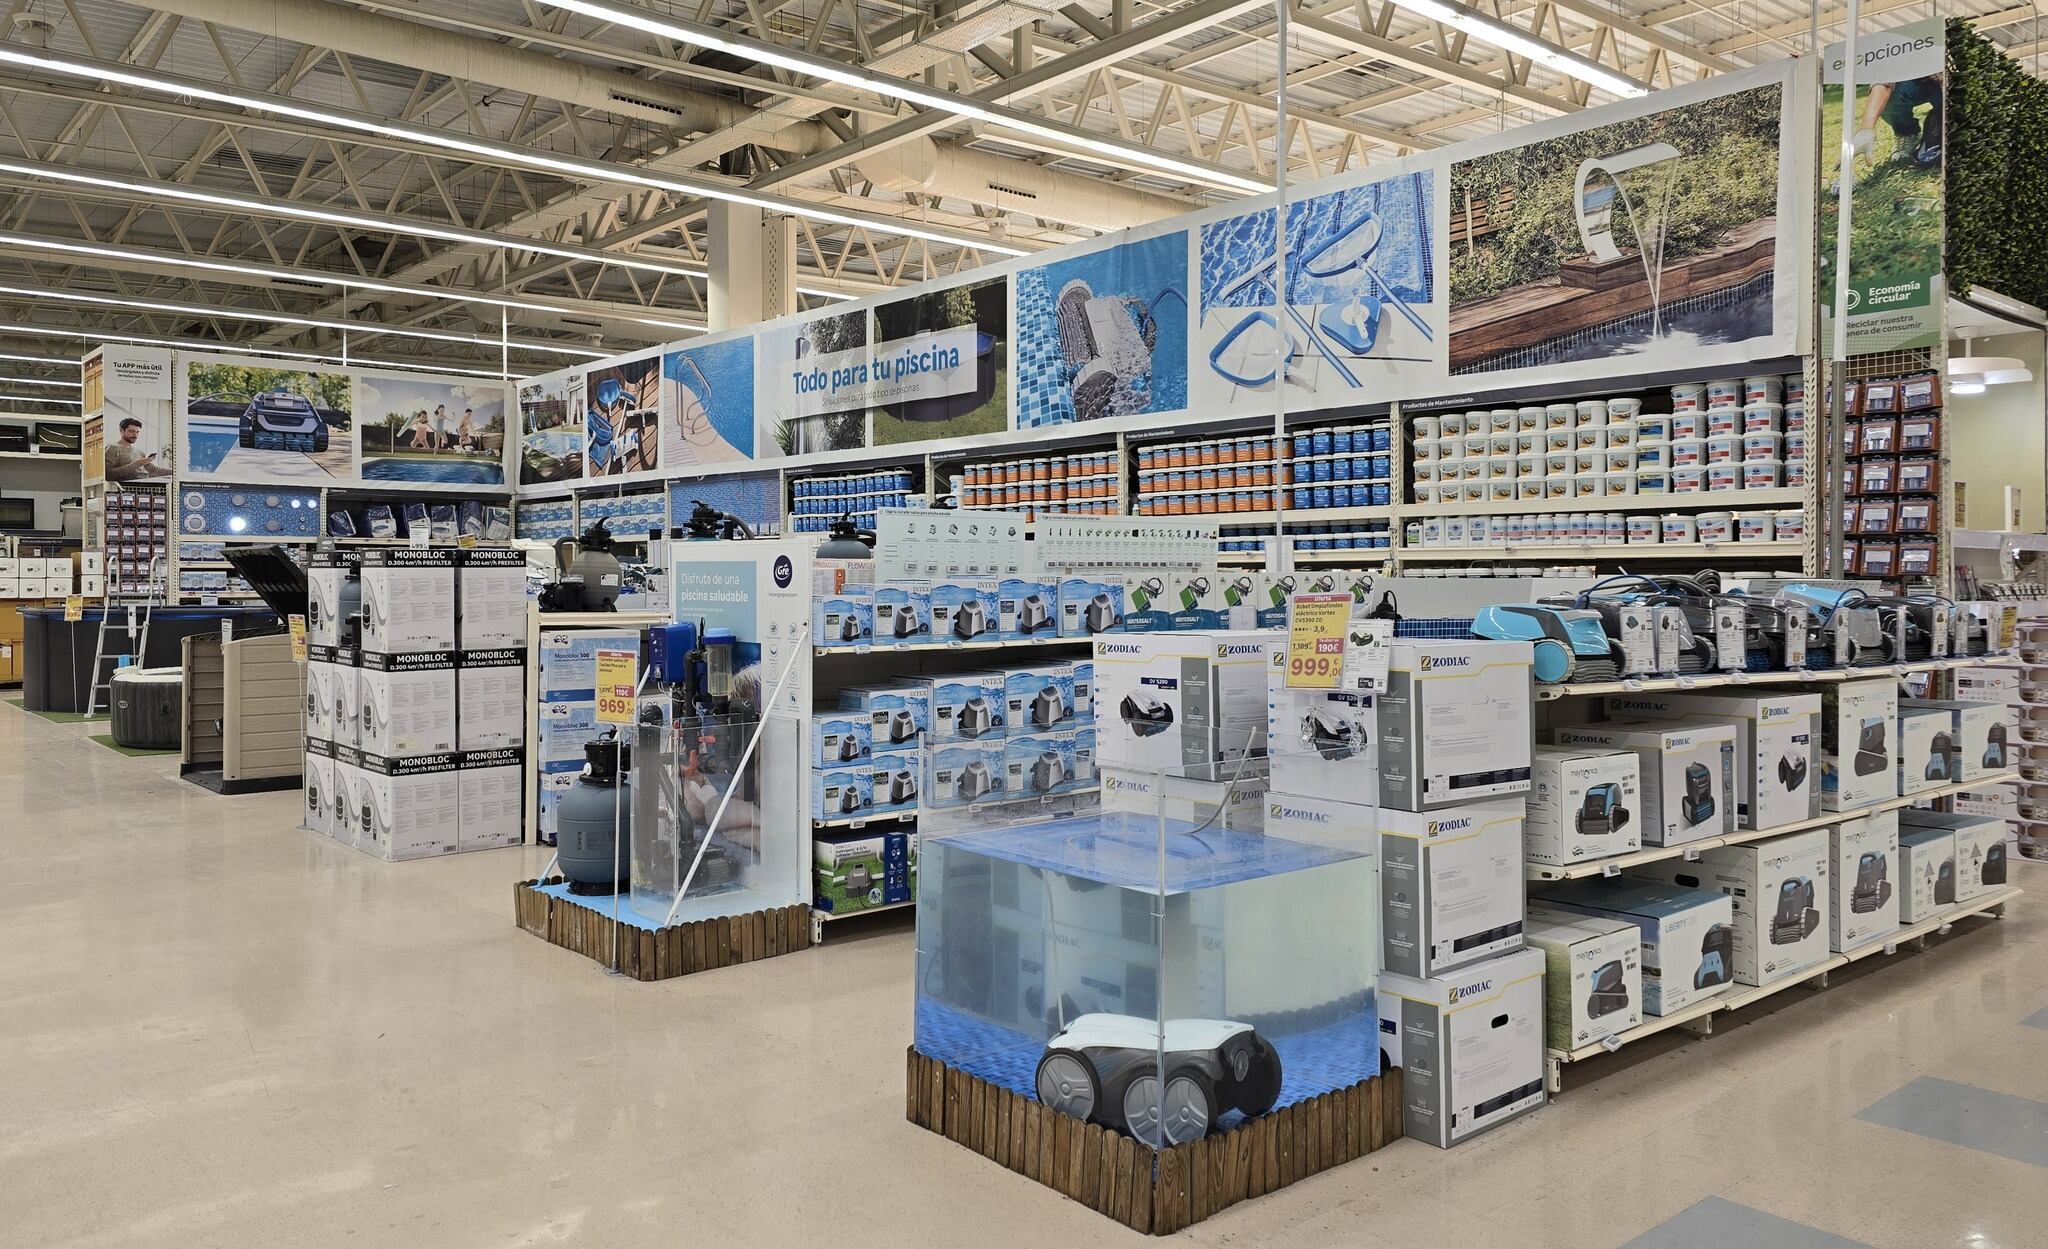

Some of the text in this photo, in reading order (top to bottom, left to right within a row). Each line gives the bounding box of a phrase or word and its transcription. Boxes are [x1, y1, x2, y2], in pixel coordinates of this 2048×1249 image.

[1868, 280, 1920, 296] Economía
[1868, 292, 1912, 304] circular
[1846, 315, 1914, 329] Reciclar nuestra
[1846, 322, 1922, 338] anera de consumir
[793, 344, 960, 394] Todo para tu piscina
[822, 393, 851, 406] Soluciones
[852, 392, 863, 402] para
[895, 383, 920, 397] piscinas
[1435, 396, 1474, 406] Mantenimiento
[394, 551, 445, 559] MONOBLOC
[471, 551, 519, 559] MONOBLOC
[681, 573, 740, 587] Disfruta de una
[681, 591, 748, 603] piscina saludable
[1106, 644, 1141, 653] ZODIAC
[1228, 645, 1262, 654] ZODIAC
[1318, 644, 1338, 652] 190€
[396, 653, 447, 663] MONOBLOC
[468, 650, 515, 660] MONOBLOC
[1291, 658, 1329, 676] 999
[1432, 656, 1470, 667] ZODIAC
[599, 698, 625, 714] 969
[1624, 701, 1667, 711] ZODIAC
[1769, 708, 1790, 716] ZODIAC
[1572, 735, 1611, 744] ZODIAC
[1672, 738, 1690, 746] ZODIAC
[466, 750, 514, 760] MONOBLOC
[400, 756, 450, 767] MONOBLOC
[1283, 808, 1328, 823] ZODIAC
[1439, 818, 1470, 832] ZODIAC
[1459, 980, 1492, 998] ZODIAC
